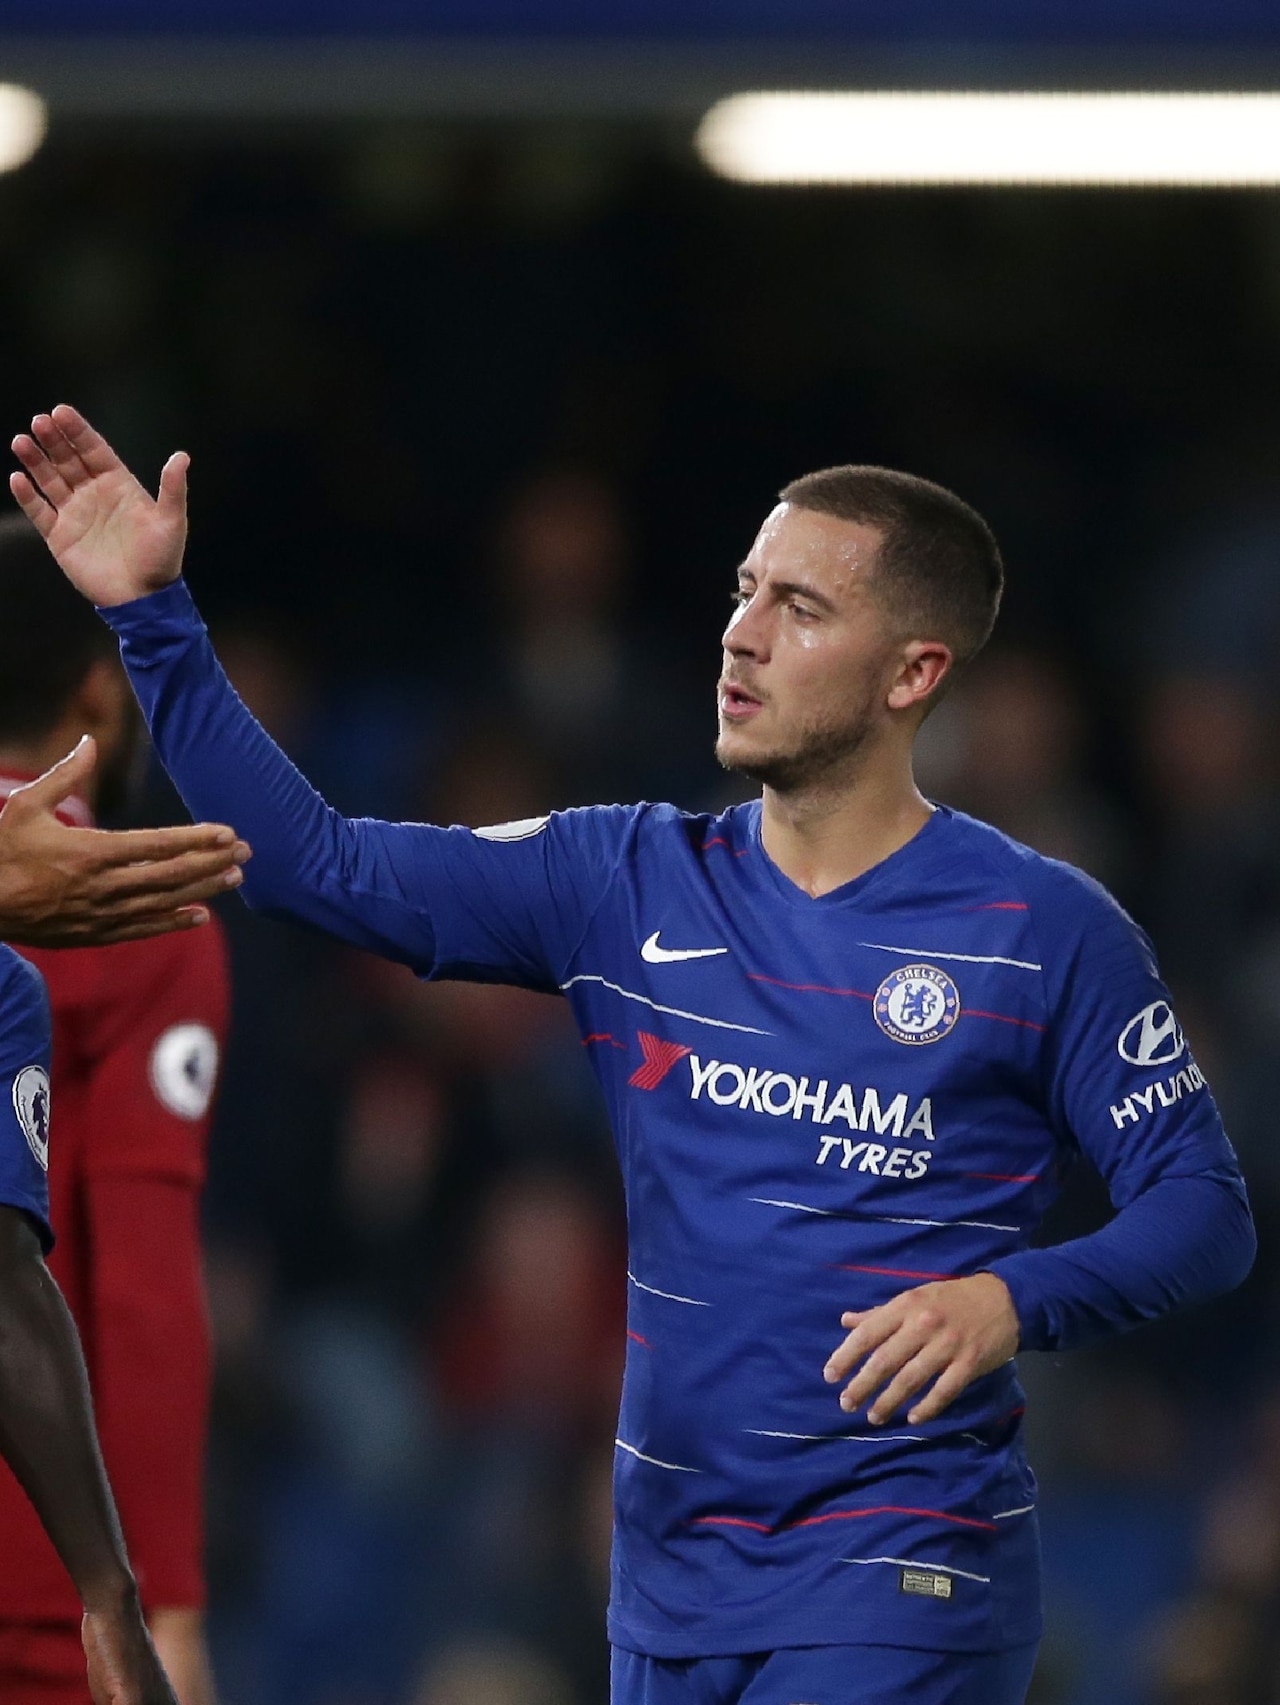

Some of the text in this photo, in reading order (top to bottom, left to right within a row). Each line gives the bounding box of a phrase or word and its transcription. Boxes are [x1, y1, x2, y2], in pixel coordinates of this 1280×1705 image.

[896, 969, 948, 989] CHELSEA
[689, 1054, 936, 1141] YOKOHAMA
[816, 1134, 933, 1180] TYRES
